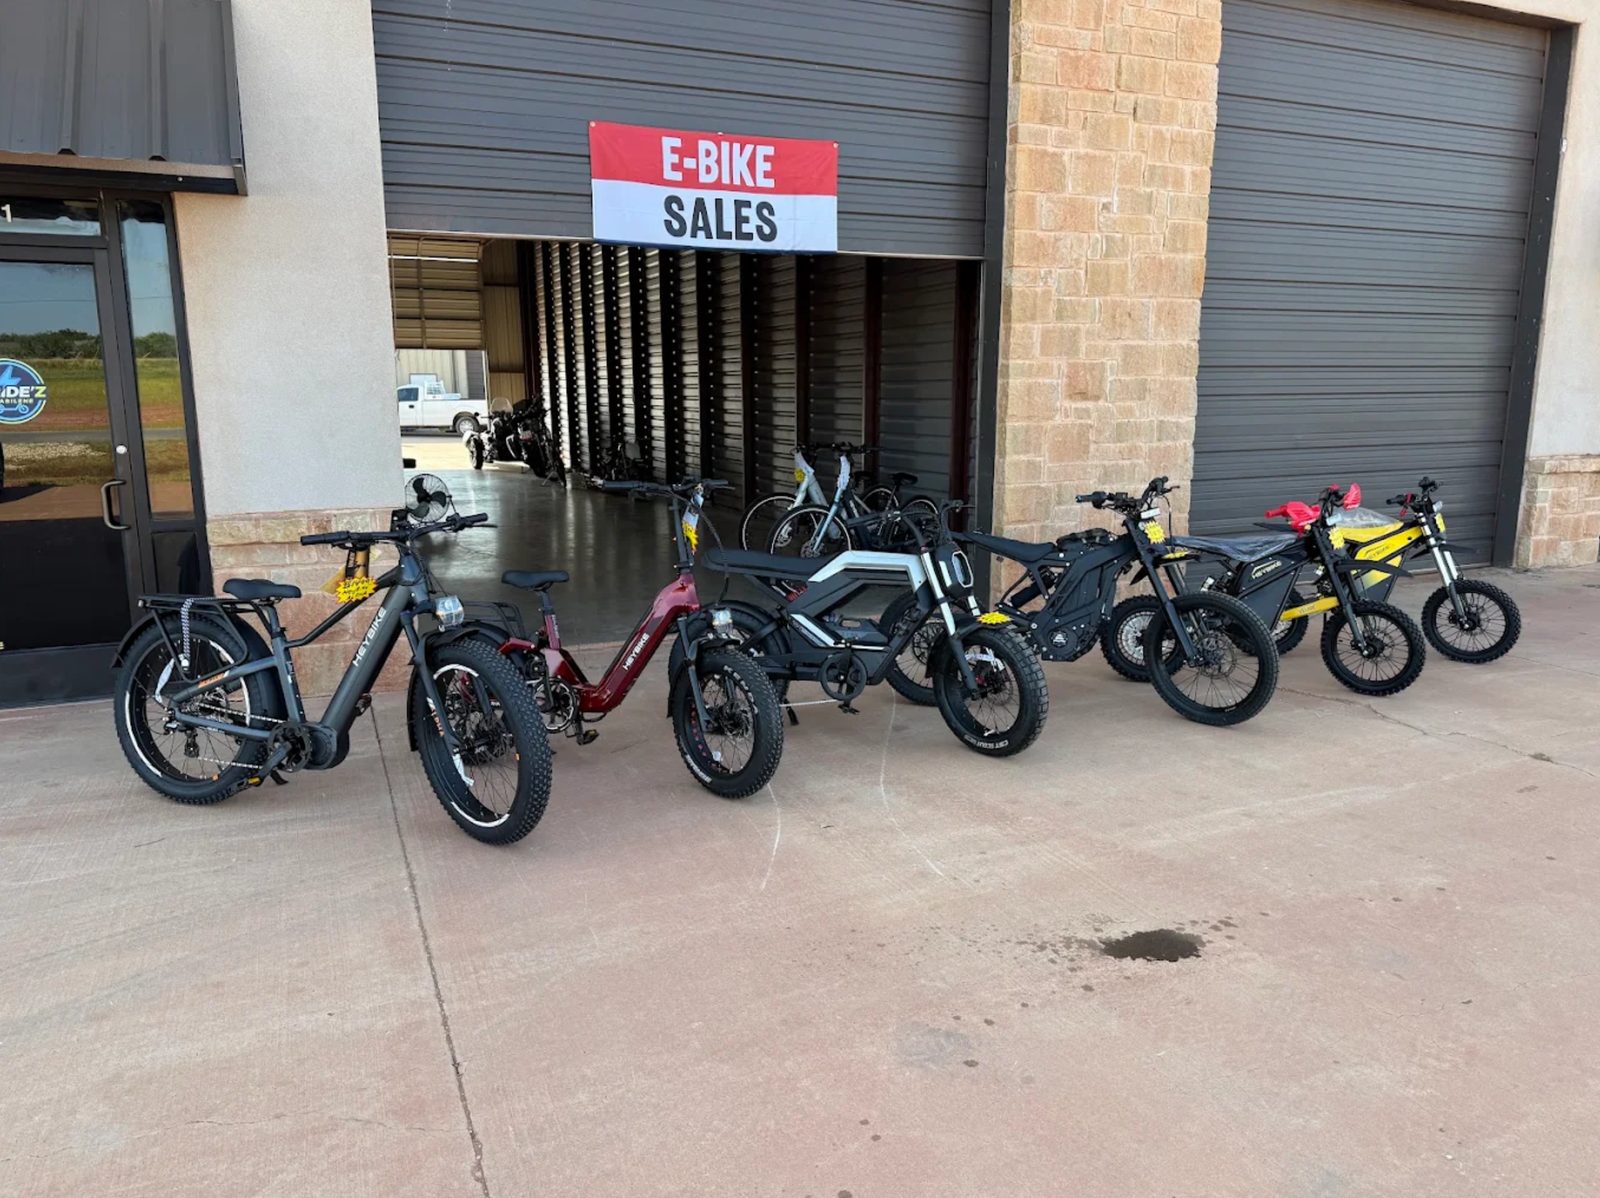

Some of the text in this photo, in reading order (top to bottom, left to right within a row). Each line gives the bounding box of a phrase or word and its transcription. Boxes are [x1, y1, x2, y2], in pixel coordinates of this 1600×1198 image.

[661, 136, 775, 188] E-BIKE
[663, 195, 778, 242] SALES
[352, 607, 387, 667] HEYBIKE
[622, 632, 650, 671] HEYBIKE
